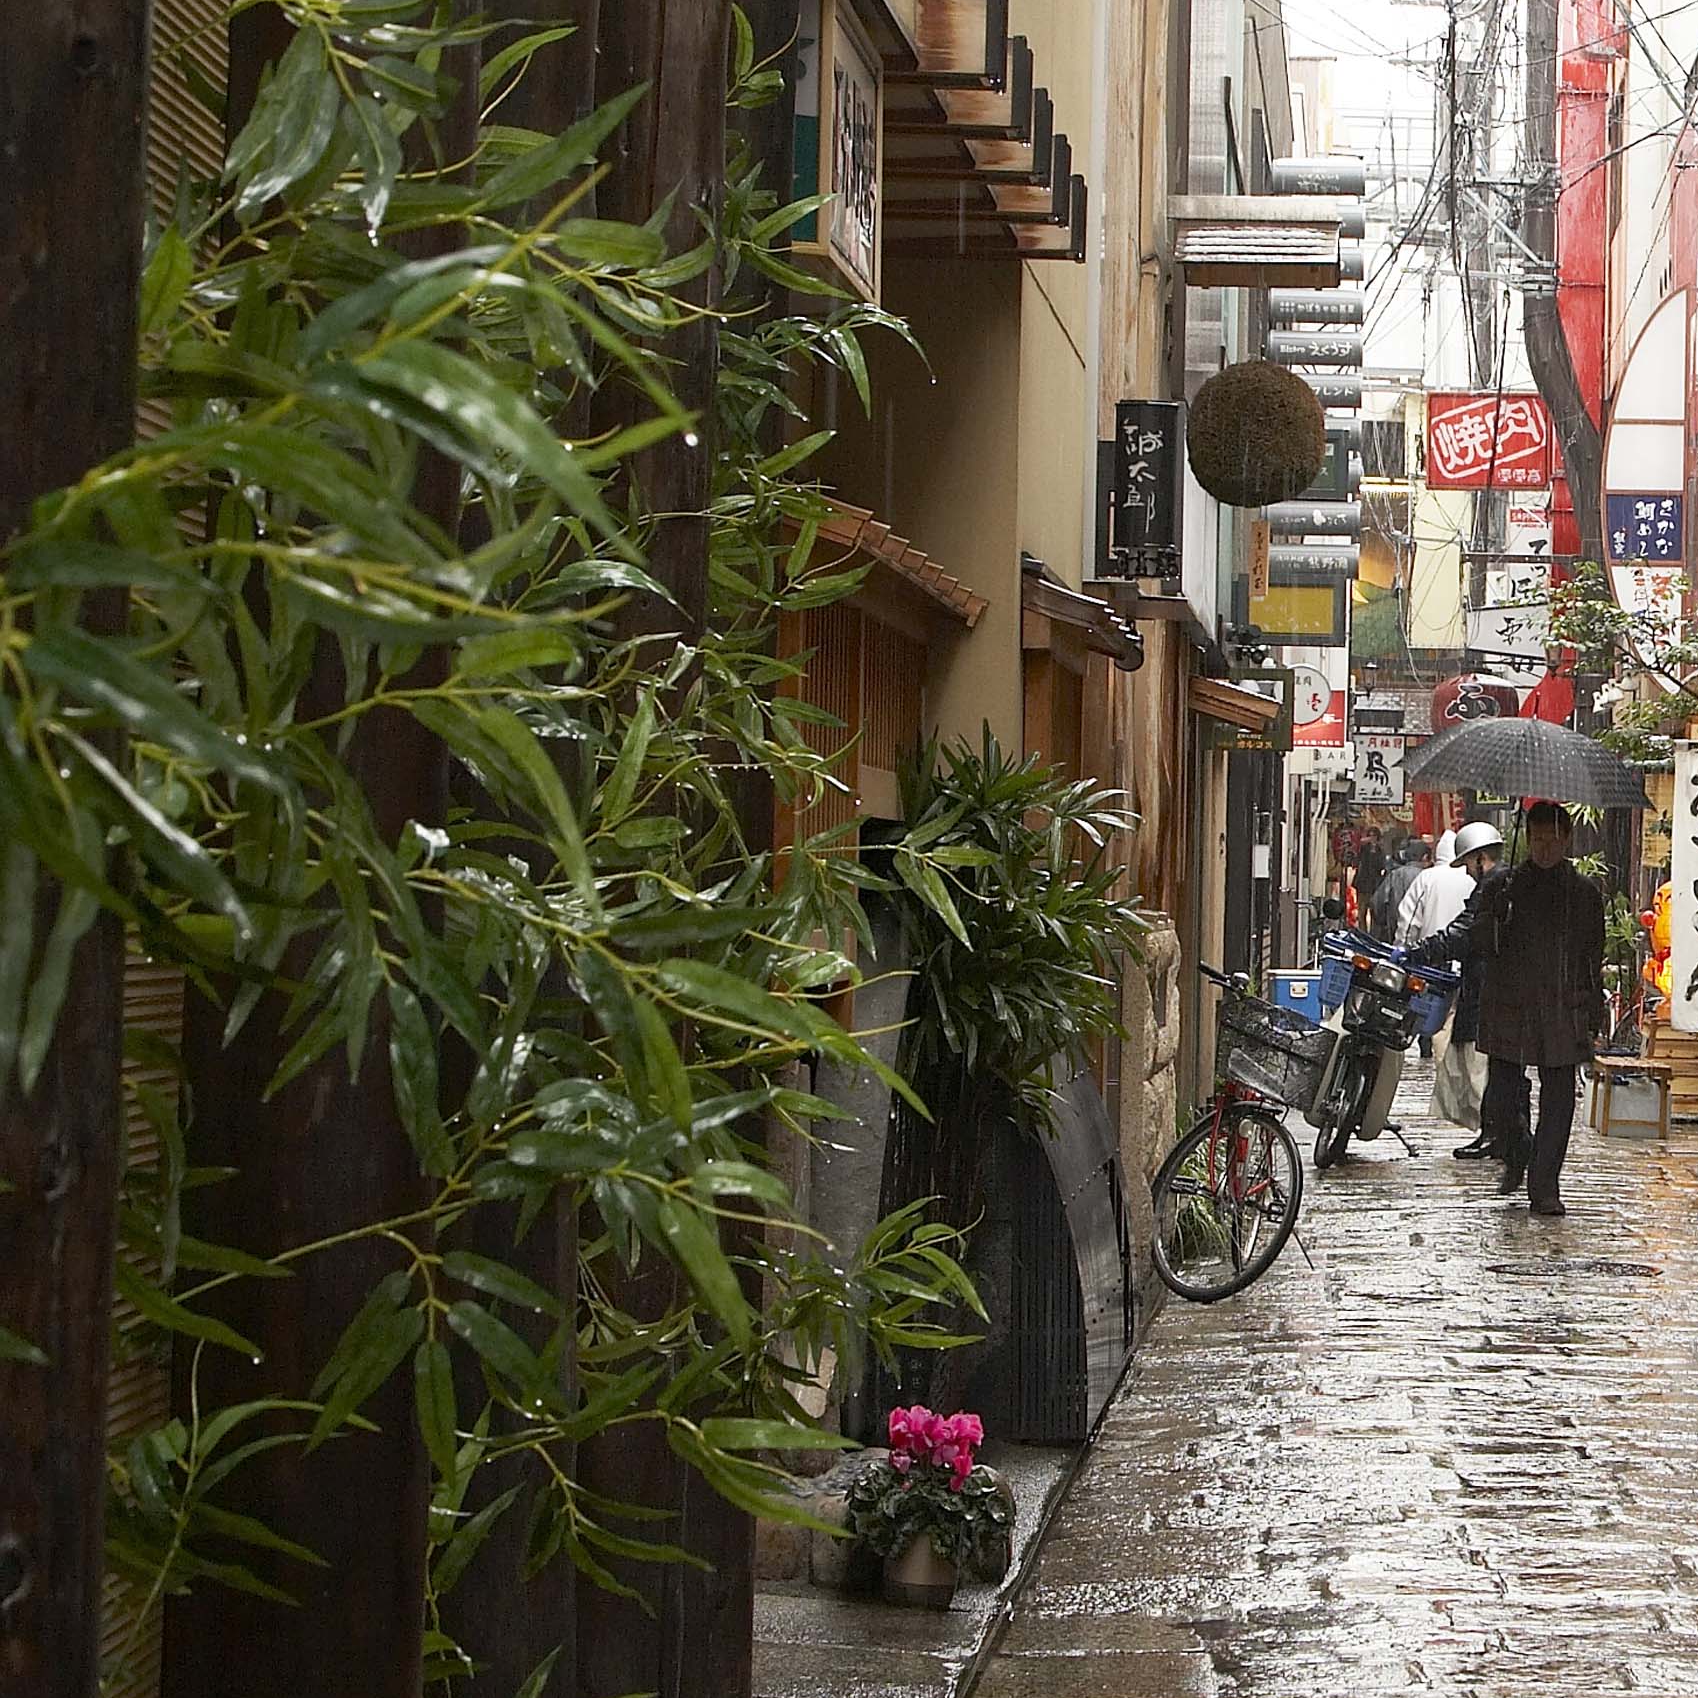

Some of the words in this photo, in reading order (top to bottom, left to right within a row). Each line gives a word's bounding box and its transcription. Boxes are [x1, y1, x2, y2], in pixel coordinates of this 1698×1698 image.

[1435, 400, 1540, 471] 焼肉
[1122, 418, 1164, 534] 誠太郎
[1634, 500, 1657, 557] 鯛めし
[1655, 499, 1675, 555] さかな
